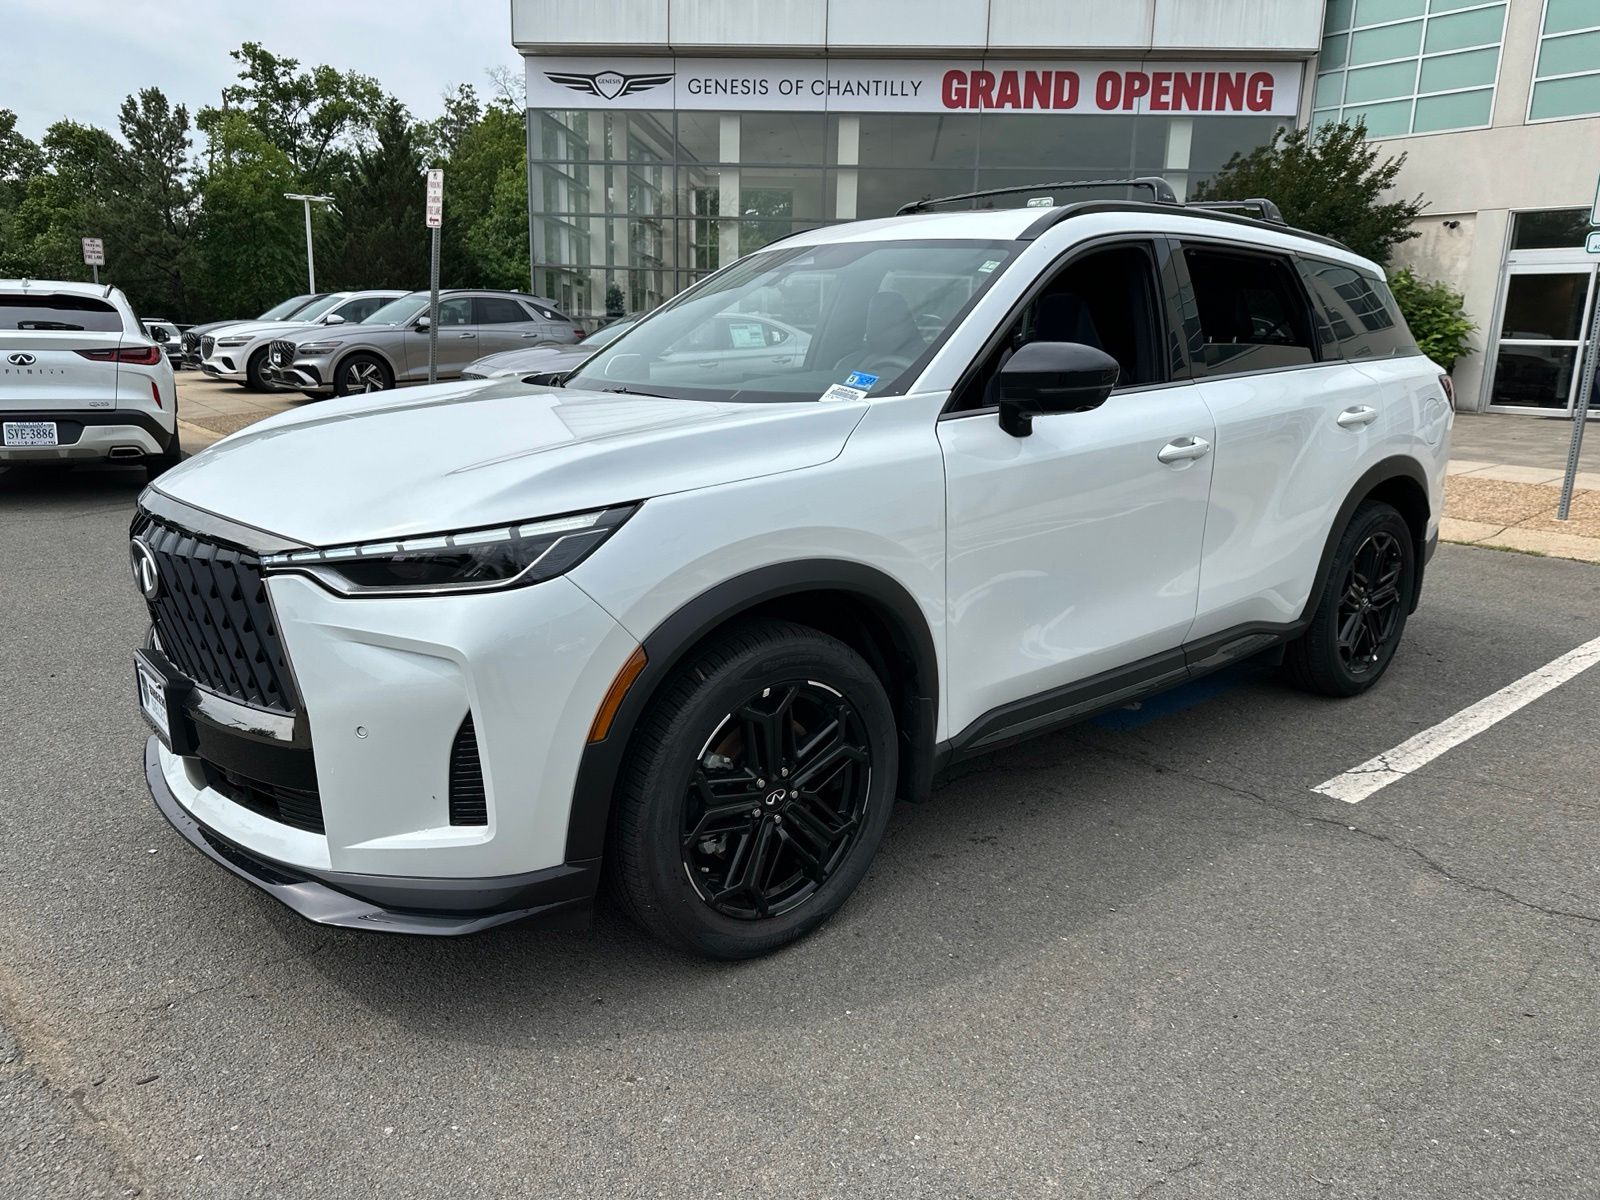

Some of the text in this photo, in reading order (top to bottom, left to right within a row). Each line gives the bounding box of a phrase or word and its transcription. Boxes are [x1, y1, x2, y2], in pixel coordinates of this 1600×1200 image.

[687, 78, 923, 97] GENESIS OF CHANTILLY
[941, 69, 1275, 112] GRAND OPENING
